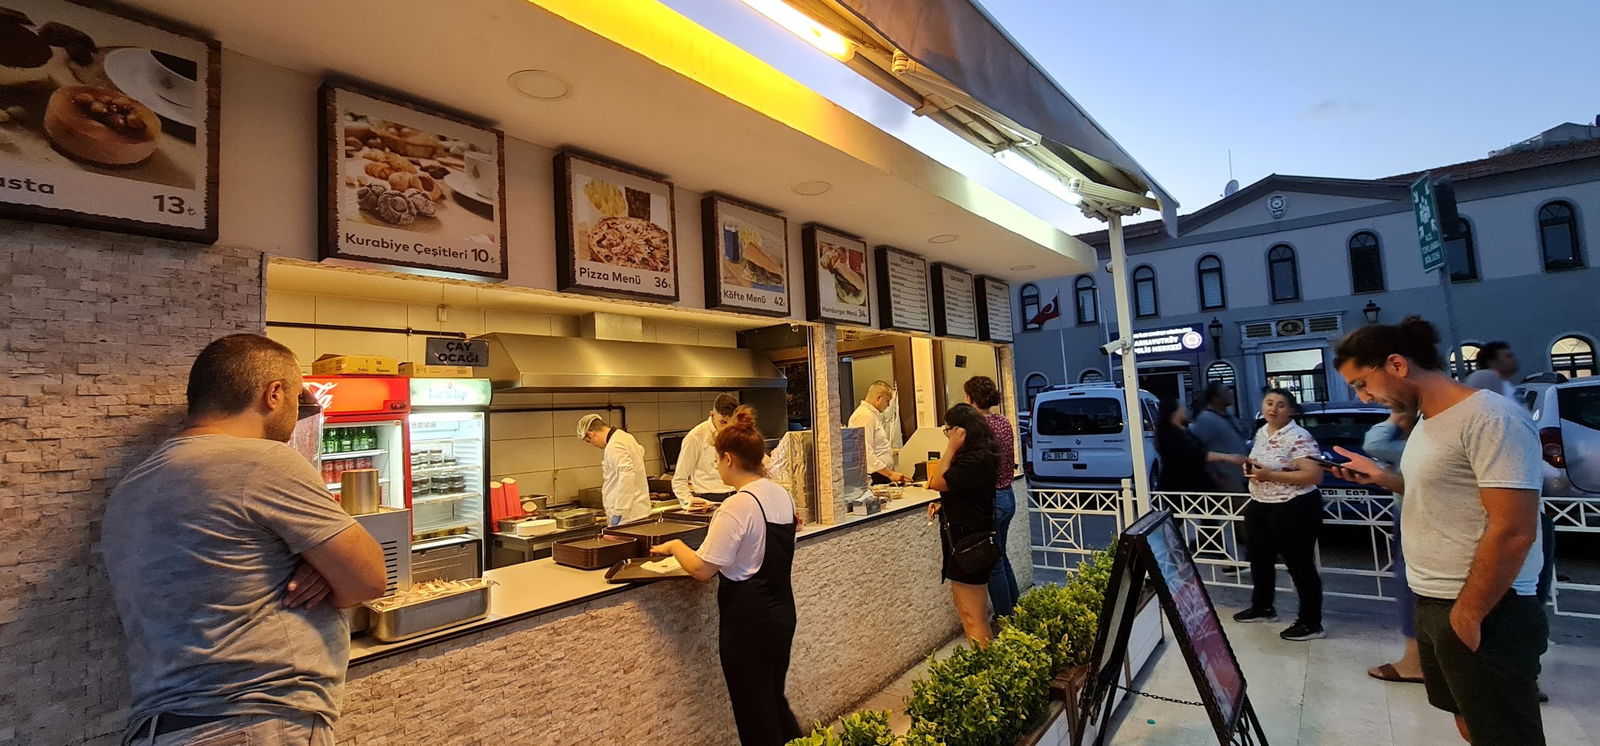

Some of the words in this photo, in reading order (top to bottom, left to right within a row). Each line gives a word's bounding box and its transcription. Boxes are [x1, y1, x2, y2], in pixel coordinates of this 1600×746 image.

[345, 233, 410, 252] Kurabiye
[413, 243, 468, 260] Çeşitleri
[579, 267, 609, 281] Pizza
[612, 272, 641, 285] Menü
[723, 289, 745, 301] Köfte
[746, 293, 767, 304] Menü
[446, 341, 472, 353] ÇAY
[438, 351, 479, 363] OCAĞI
